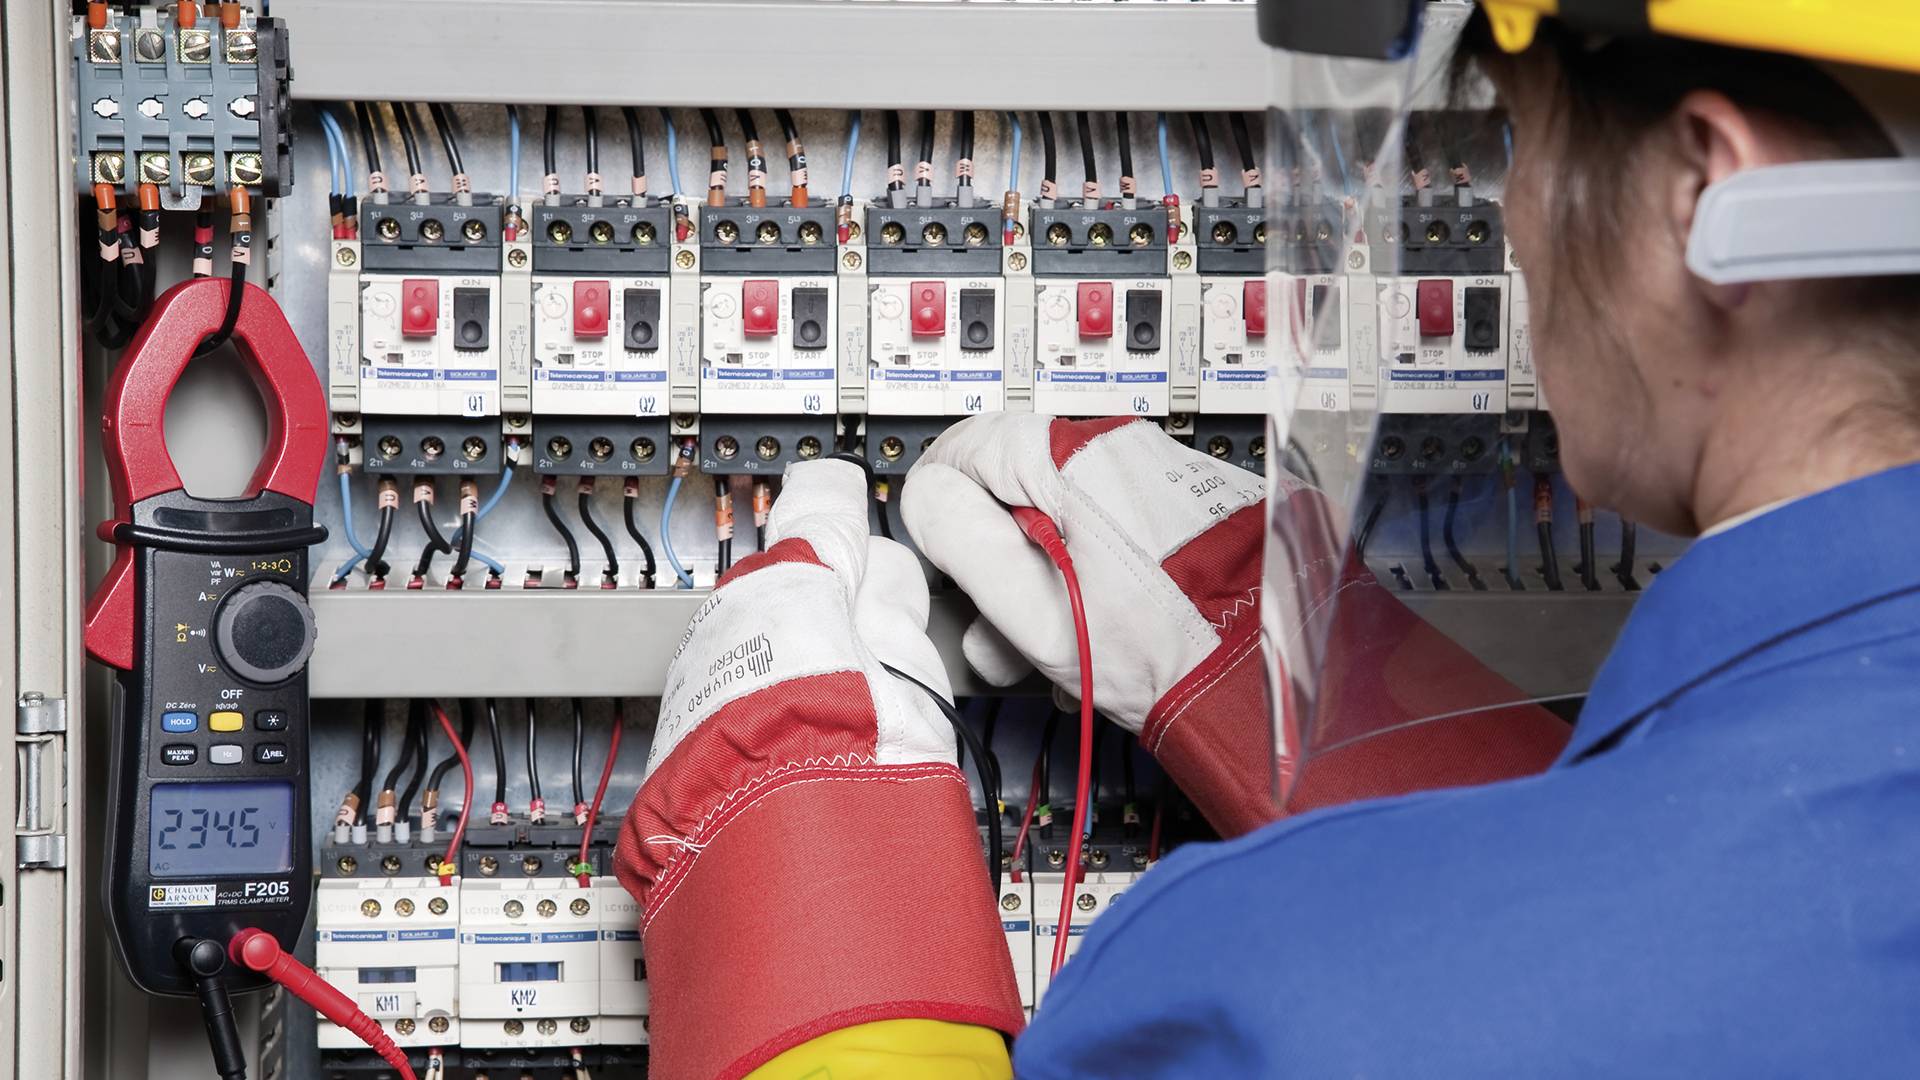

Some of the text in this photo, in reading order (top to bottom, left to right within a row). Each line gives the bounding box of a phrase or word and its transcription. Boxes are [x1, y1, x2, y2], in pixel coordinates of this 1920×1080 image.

[410, 350, 432, 358] STOP
[748, 352, 770, 360] STOP
[794, 352, 822, 360] START
[1082, 352, 1104, 360] STOP
[1422, 350, 1444, 358] STOP
[378, 370, 428, 378] Telemecanique
[550, 372, 600, 380] Telemecanique
[718, 370, 768, 378] Telemecanique
[886, 371, 936, 379] Telemecanique
[1392, 372, 1440, 380] Telemecanique
[468, 396, 484, 412] Q1
[640, 396, 656, 413] Q2
[804, 395, 821, 412] Q3
[966, 396, 982, 412] Q4
[1134, 396, 1150, 412] Q5
[1320, 392, 1336, 409] Q6
[1473, 394, 1489, 410] Q7
[1190, 475, 1226, 498] 0075
[252, 562, 277, 570] 1-2-3
[224, 568, 235, 578] W
[198, 592, 208, 602] A
[198, 664, 206, 674] V
[688, 664, 745, 713] GUYARD
[221, 690, 244, 700] OFF
[170, 718, 192, 726] HOLD
[158, 808, 260, 850] 234.5
[268, 822, 276, 830] V
[154, 862, 170, 871] AC
[244, 881, 290, 896] F205
[168, 894, 209, 902] ARNOUX
[265, 896, 289, 904] METER
[333, 932, 384, 940] Telemecanique
[512, 990, 536, 1006] KM2
[376, 996, 400, 1012] KM1
